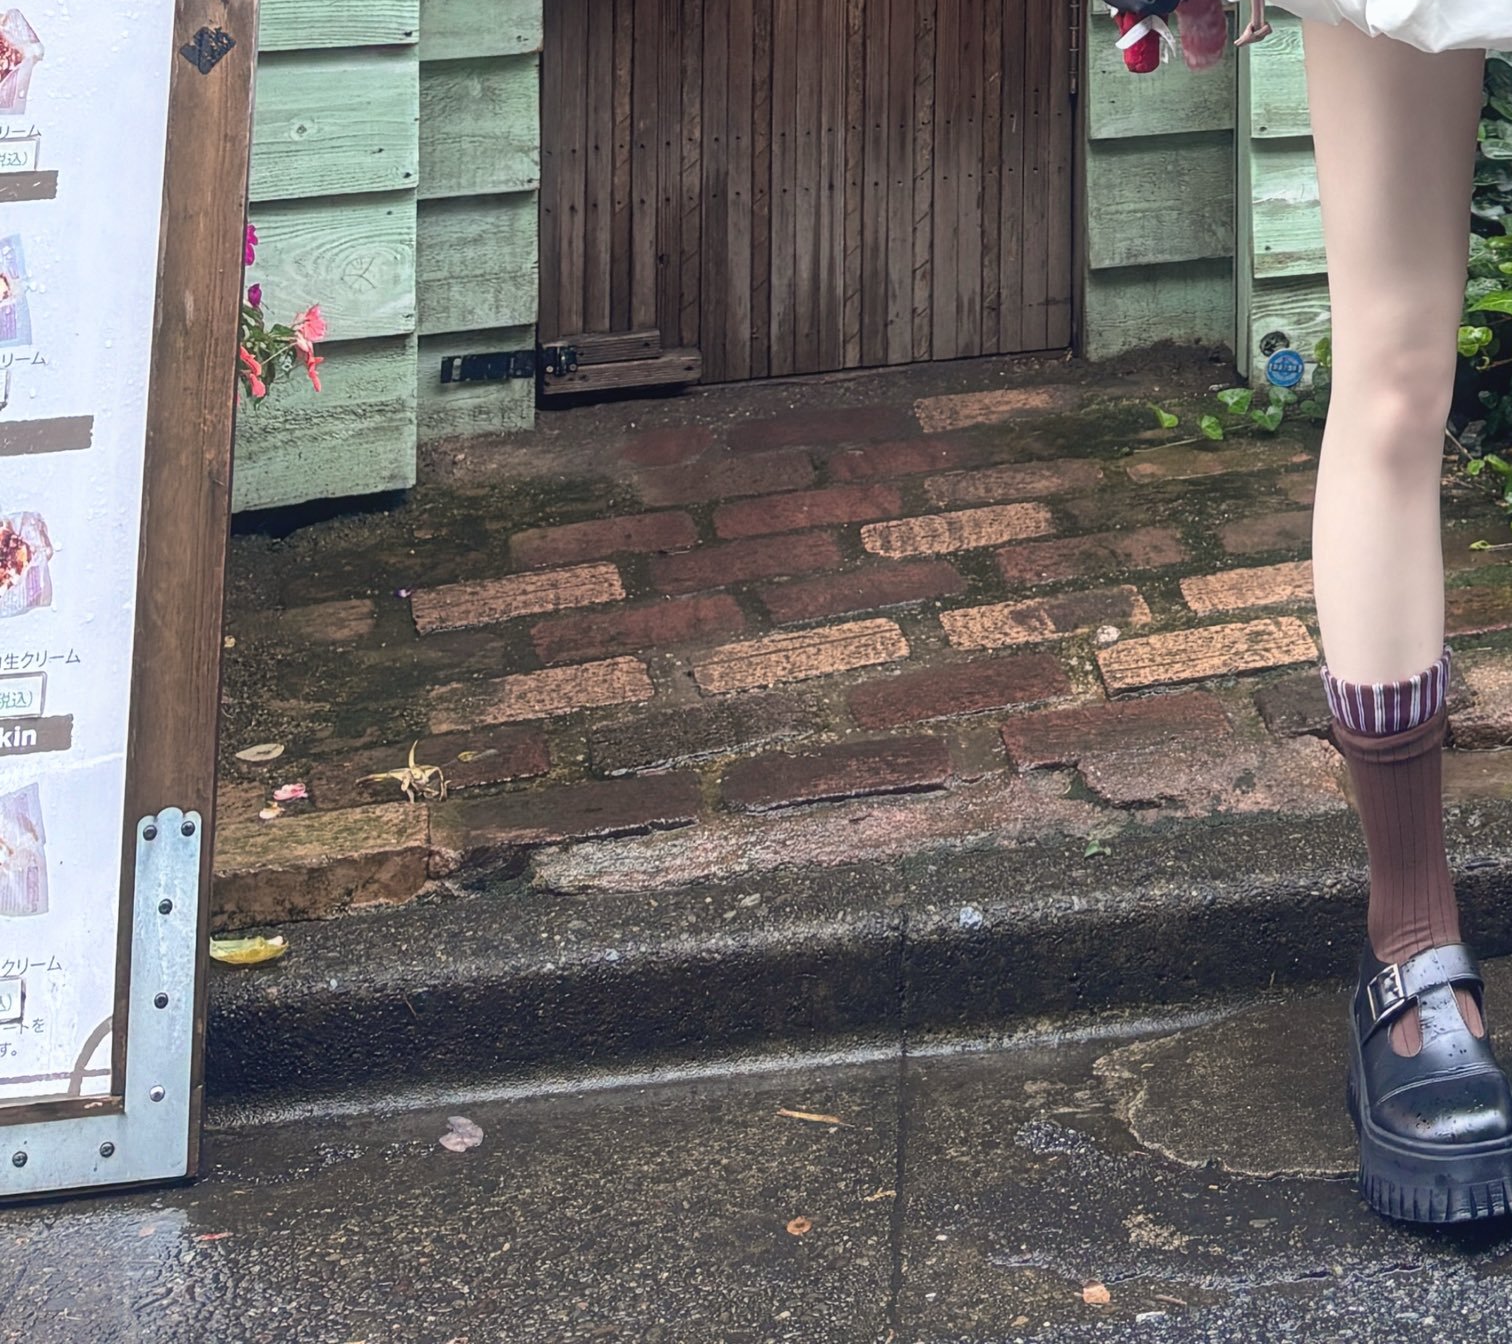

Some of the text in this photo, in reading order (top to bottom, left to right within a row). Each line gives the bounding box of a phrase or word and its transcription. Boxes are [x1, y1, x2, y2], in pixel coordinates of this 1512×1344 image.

[0, 648, 81, 671] 生クリーム
